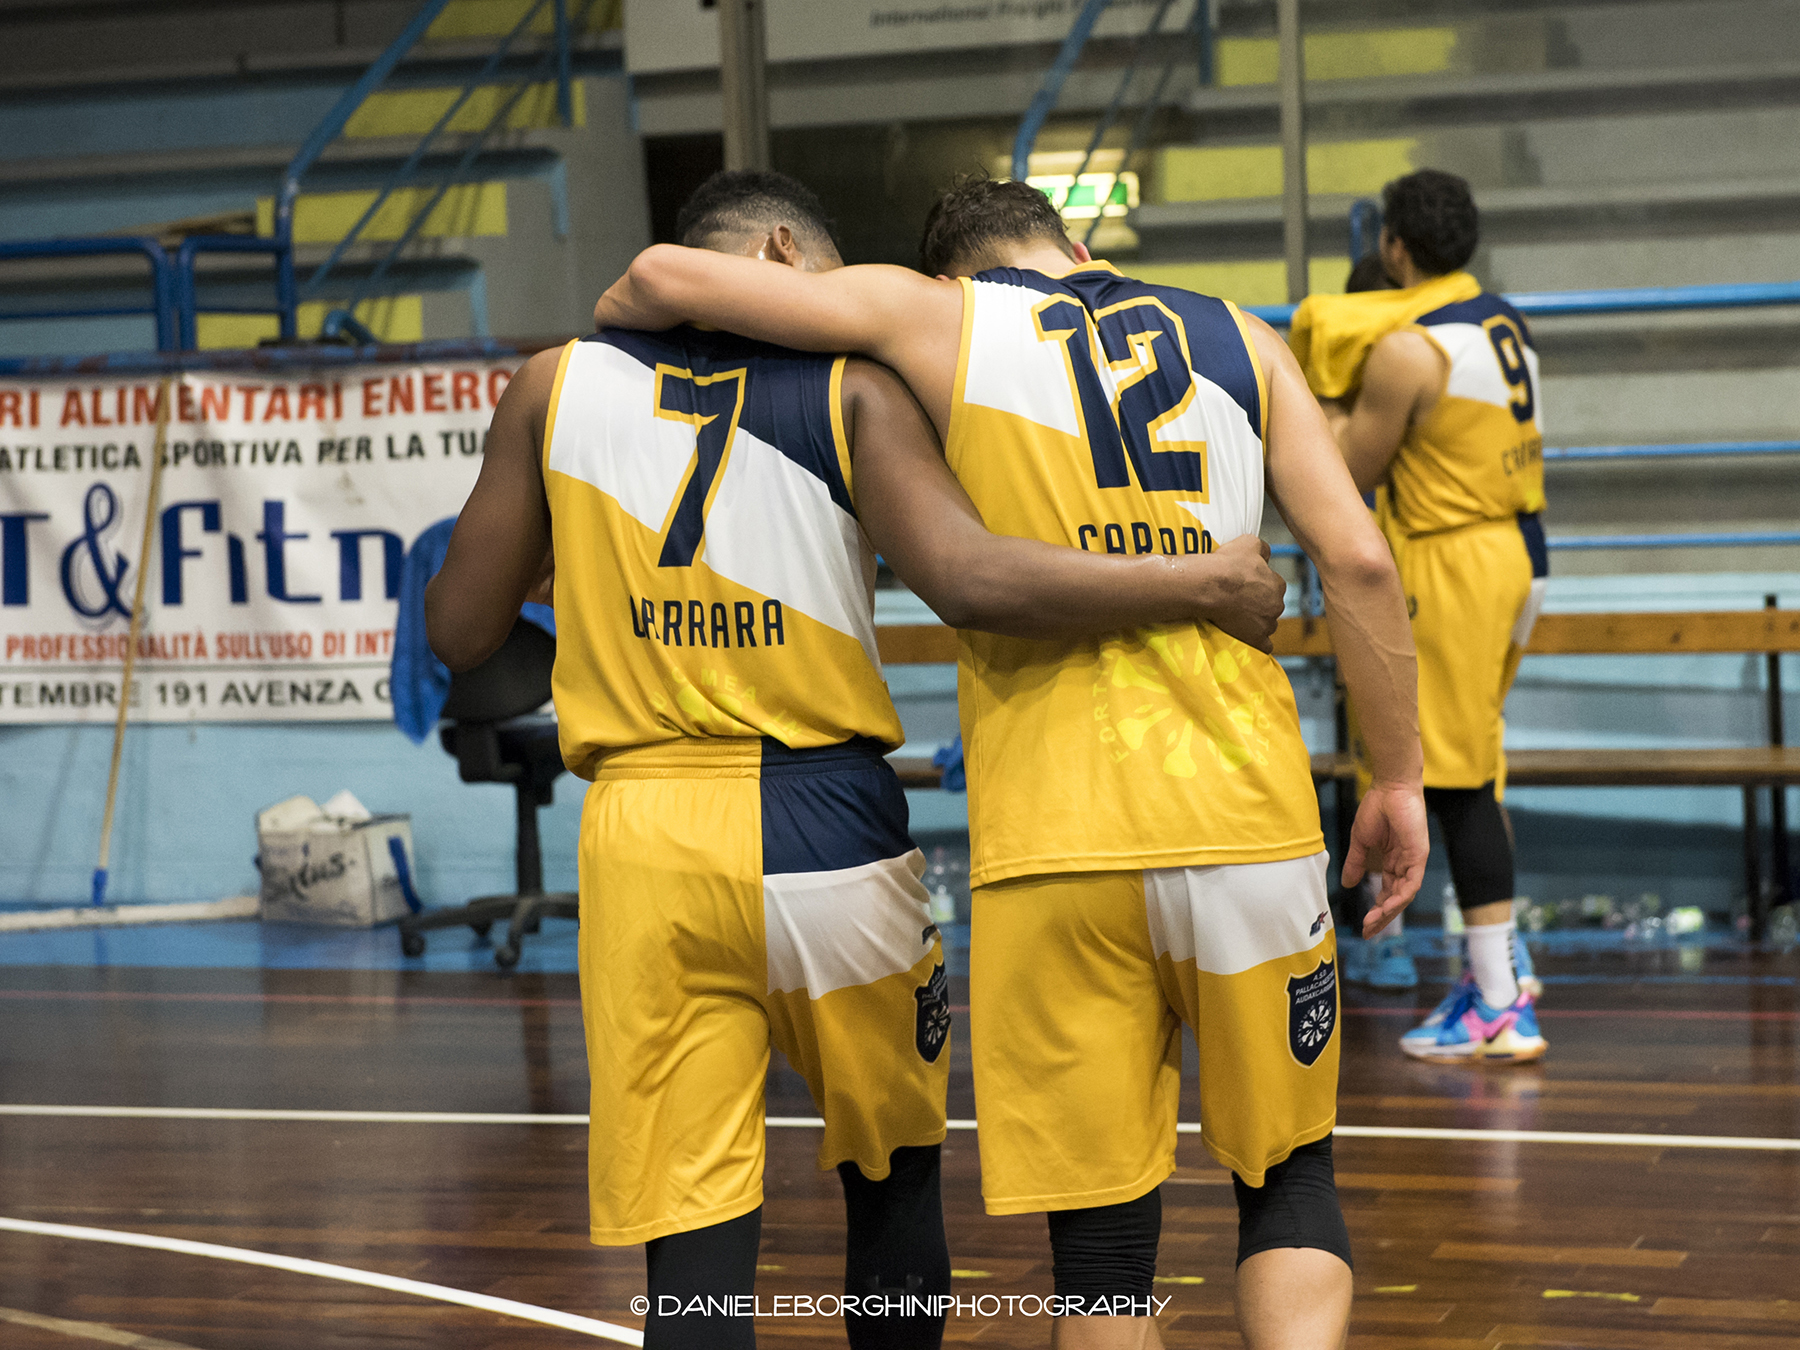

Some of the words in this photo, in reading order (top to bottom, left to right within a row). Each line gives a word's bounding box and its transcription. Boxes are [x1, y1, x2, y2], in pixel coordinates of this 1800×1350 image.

[1482, 314, 1535, 425] 9
[60, 380, 342, 427] ALIMENTARI
[1031, 293, 1209, 504] 12
[0, 443, 141, 471] ATLETICA
[317, 435, 372, 464] PER
[386, 431, 425, 459] LA
[439, 428, 488, 455] TU
[654, 363, 747, 568] 7
[216, 630, 312, 660] SULL'USO
[323, 630, 346, 657] DI
[156, 681, 207, 706] 191
[221, 678, 362, 705] AVENZA
